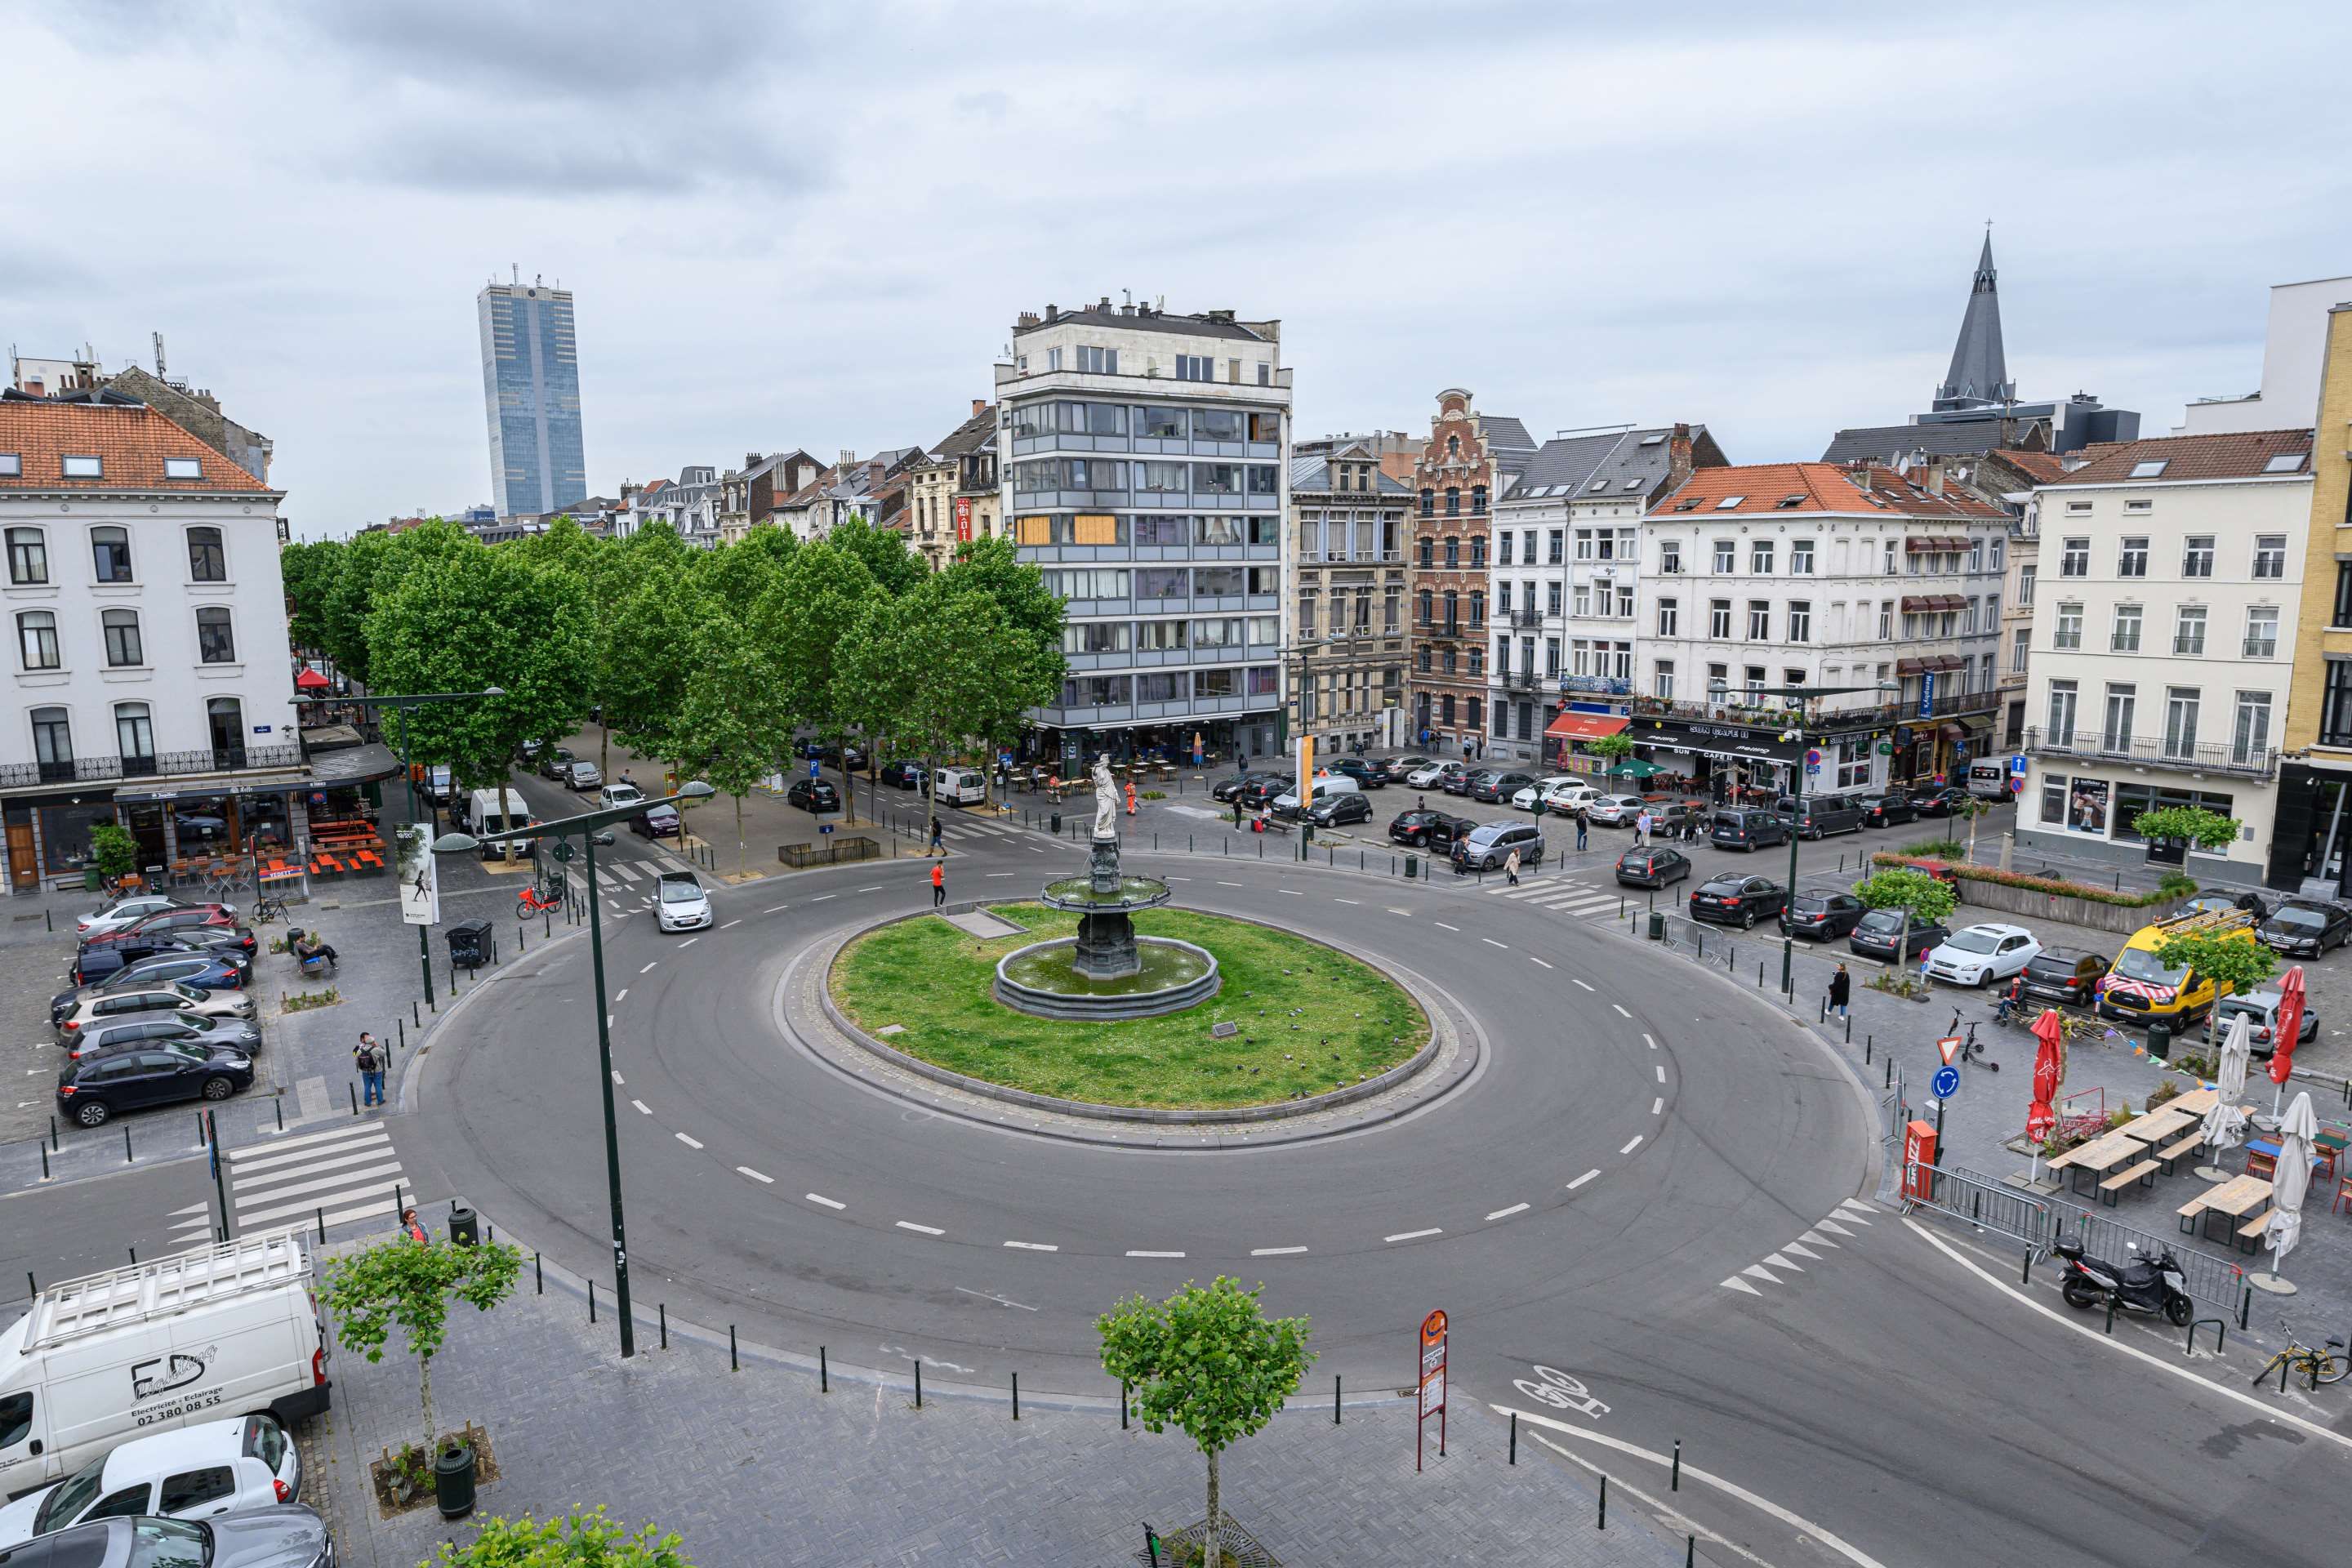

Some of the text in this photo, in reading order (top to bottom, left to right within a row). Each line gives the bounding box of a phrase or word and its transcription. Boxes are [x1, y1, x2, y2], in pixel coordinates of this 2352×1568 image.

[1690, 725, 1710, 734] SUN
[811, 761, 817, 771] P
[131, 1400, 176, 1417] Electricité
[184, 1387, 223, 1402] Eclairage
[137, 1395, 221, 1427] 02 380 08 55
